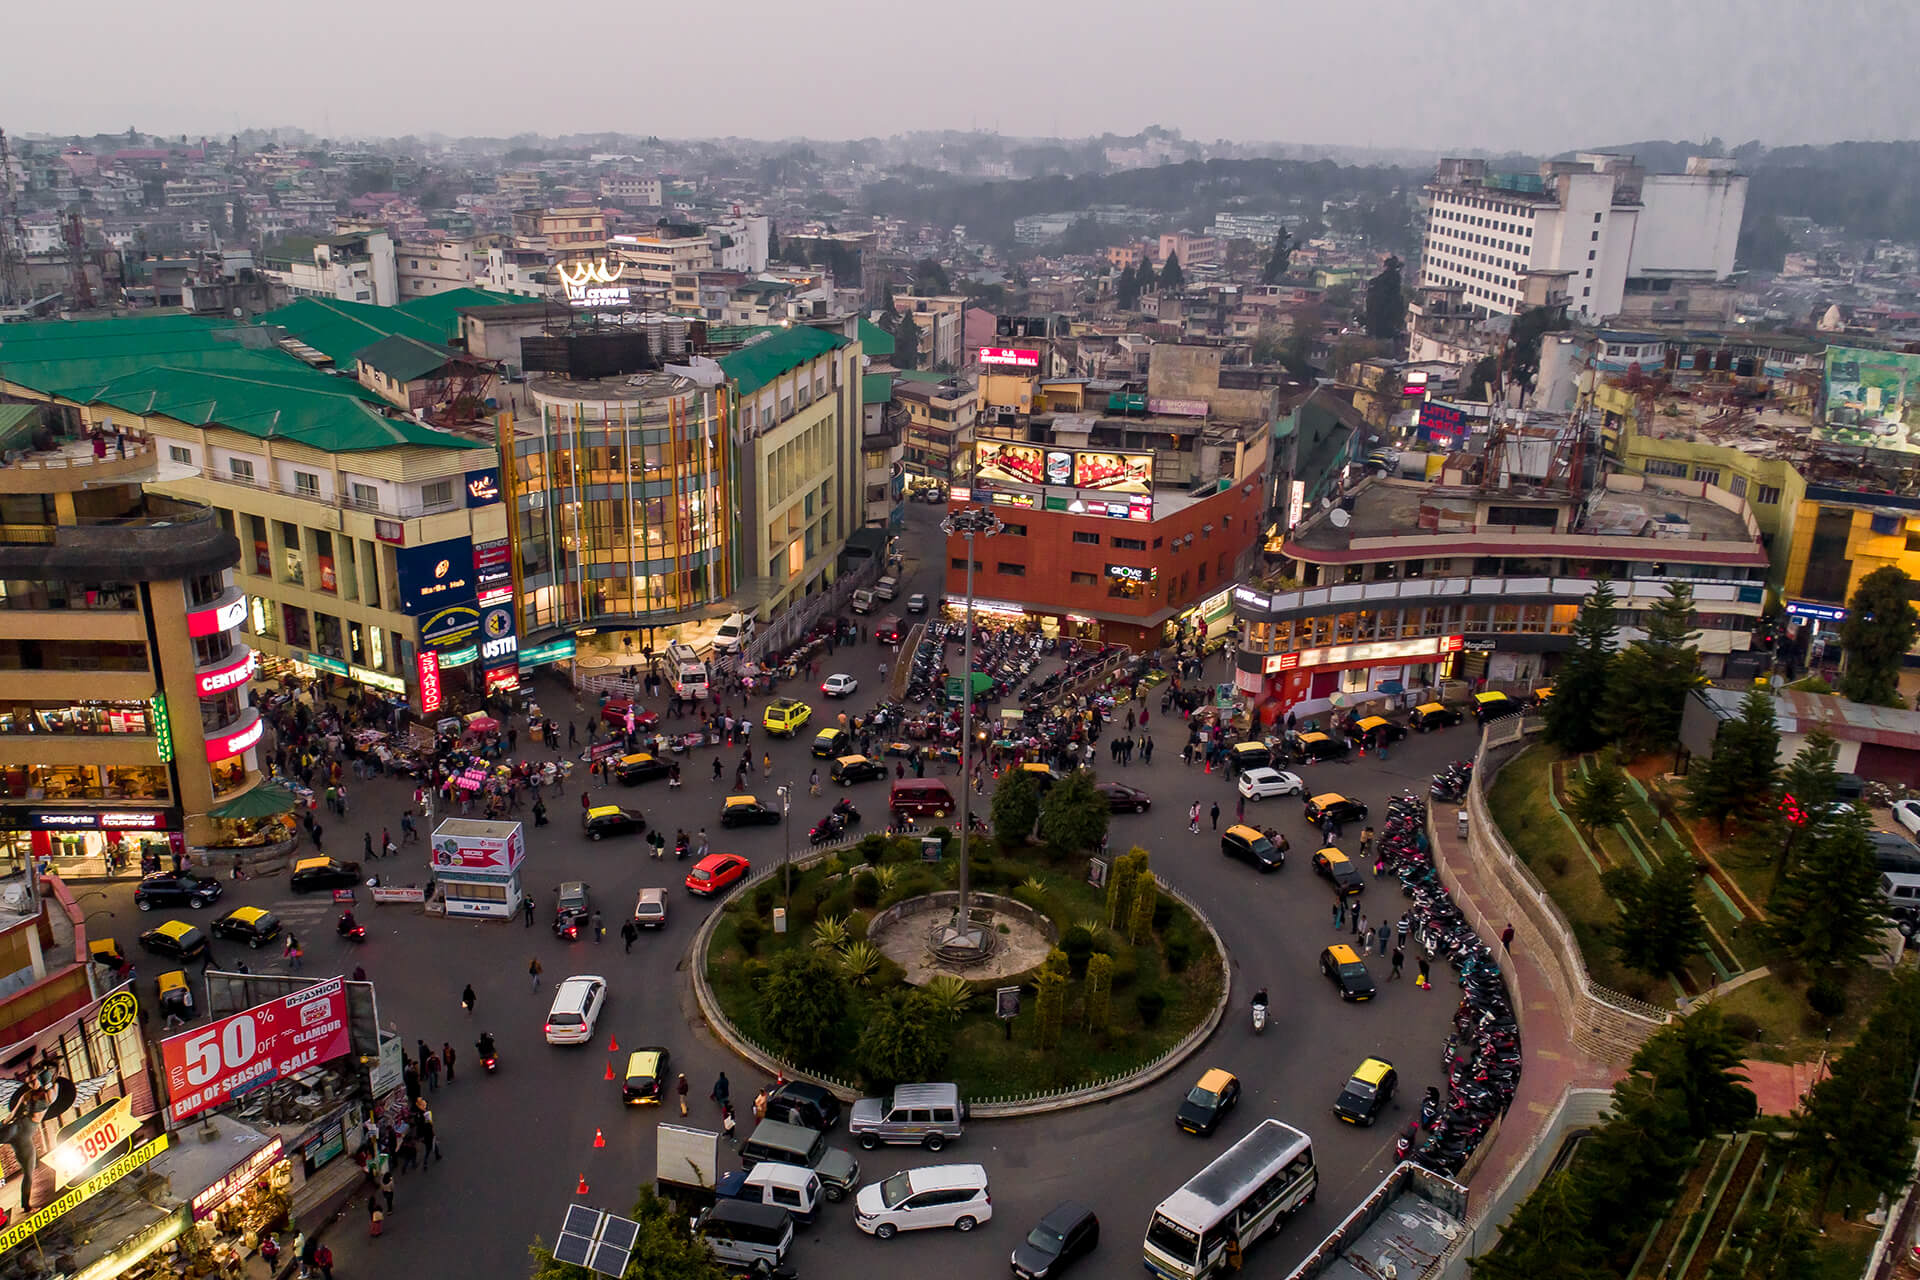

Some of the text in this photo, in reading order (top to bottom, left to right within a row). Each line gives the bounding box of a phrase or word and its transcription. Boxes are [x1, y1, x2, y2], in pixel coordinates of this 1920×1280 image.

[201, 664, 249, 691] CENTRE
[257, 1034, 278, 1055] OFF
[293, 1019, 342, 1045] GLAMOUR
[175, 1093, 202, 1117] END
[203, 1083, 221, 1102] OF
[221, 1057, 273, 1092] SEASON
[279, 1046, 319, 1076] SALE
[0, 1142, 158, 1251] 9863099990 8258860607
[193, 1134, 283, 1210] KHASI EMPORIUM
